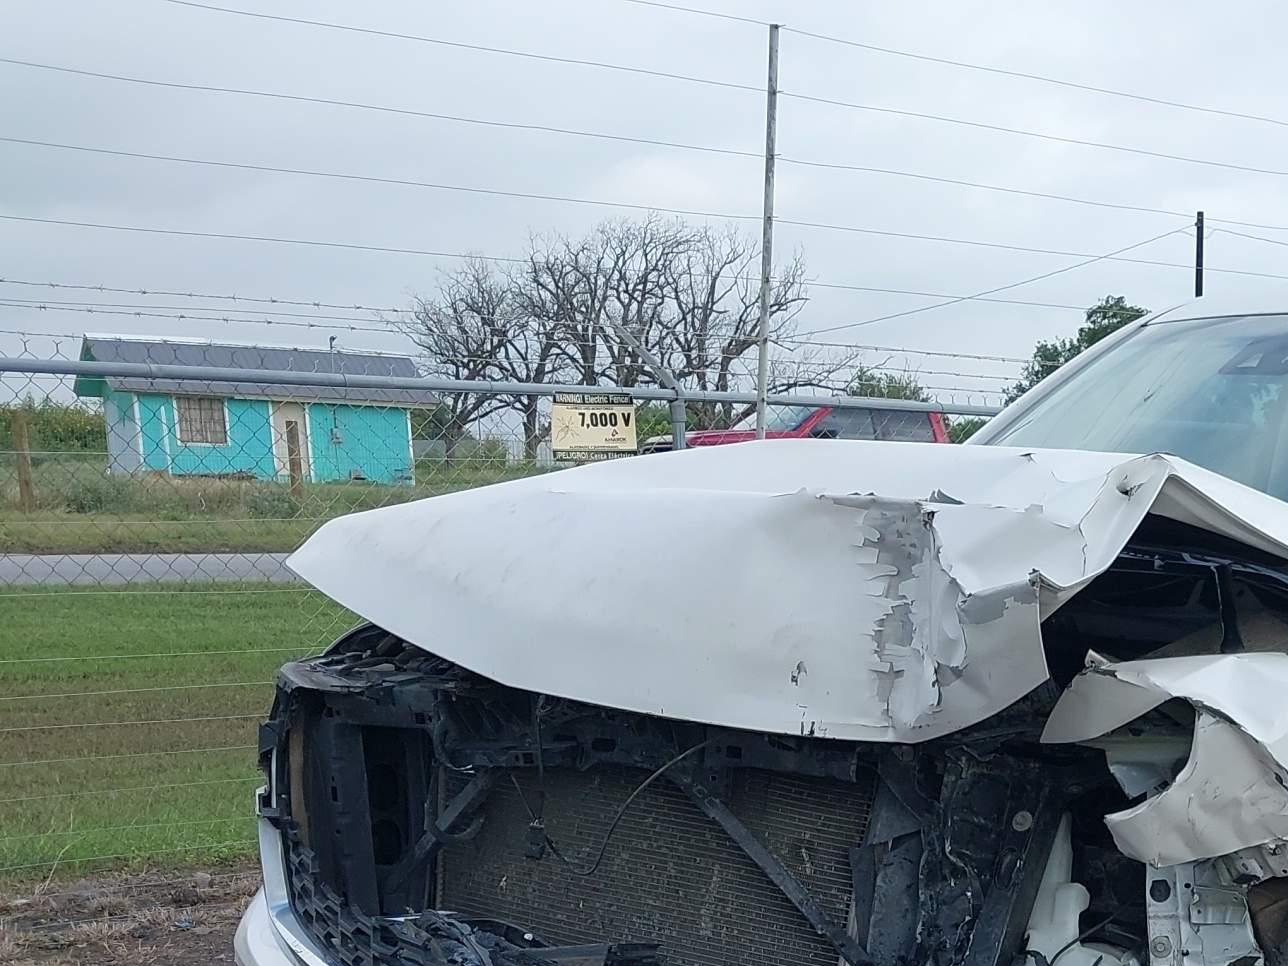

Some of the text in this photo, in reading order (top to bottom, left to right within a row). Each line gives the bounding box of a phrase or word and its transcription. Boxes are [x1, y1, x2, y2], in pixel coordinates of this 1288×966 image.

[585, 395, 608, 404] Electric
[578, 412, 632, 429] 7,000 V
